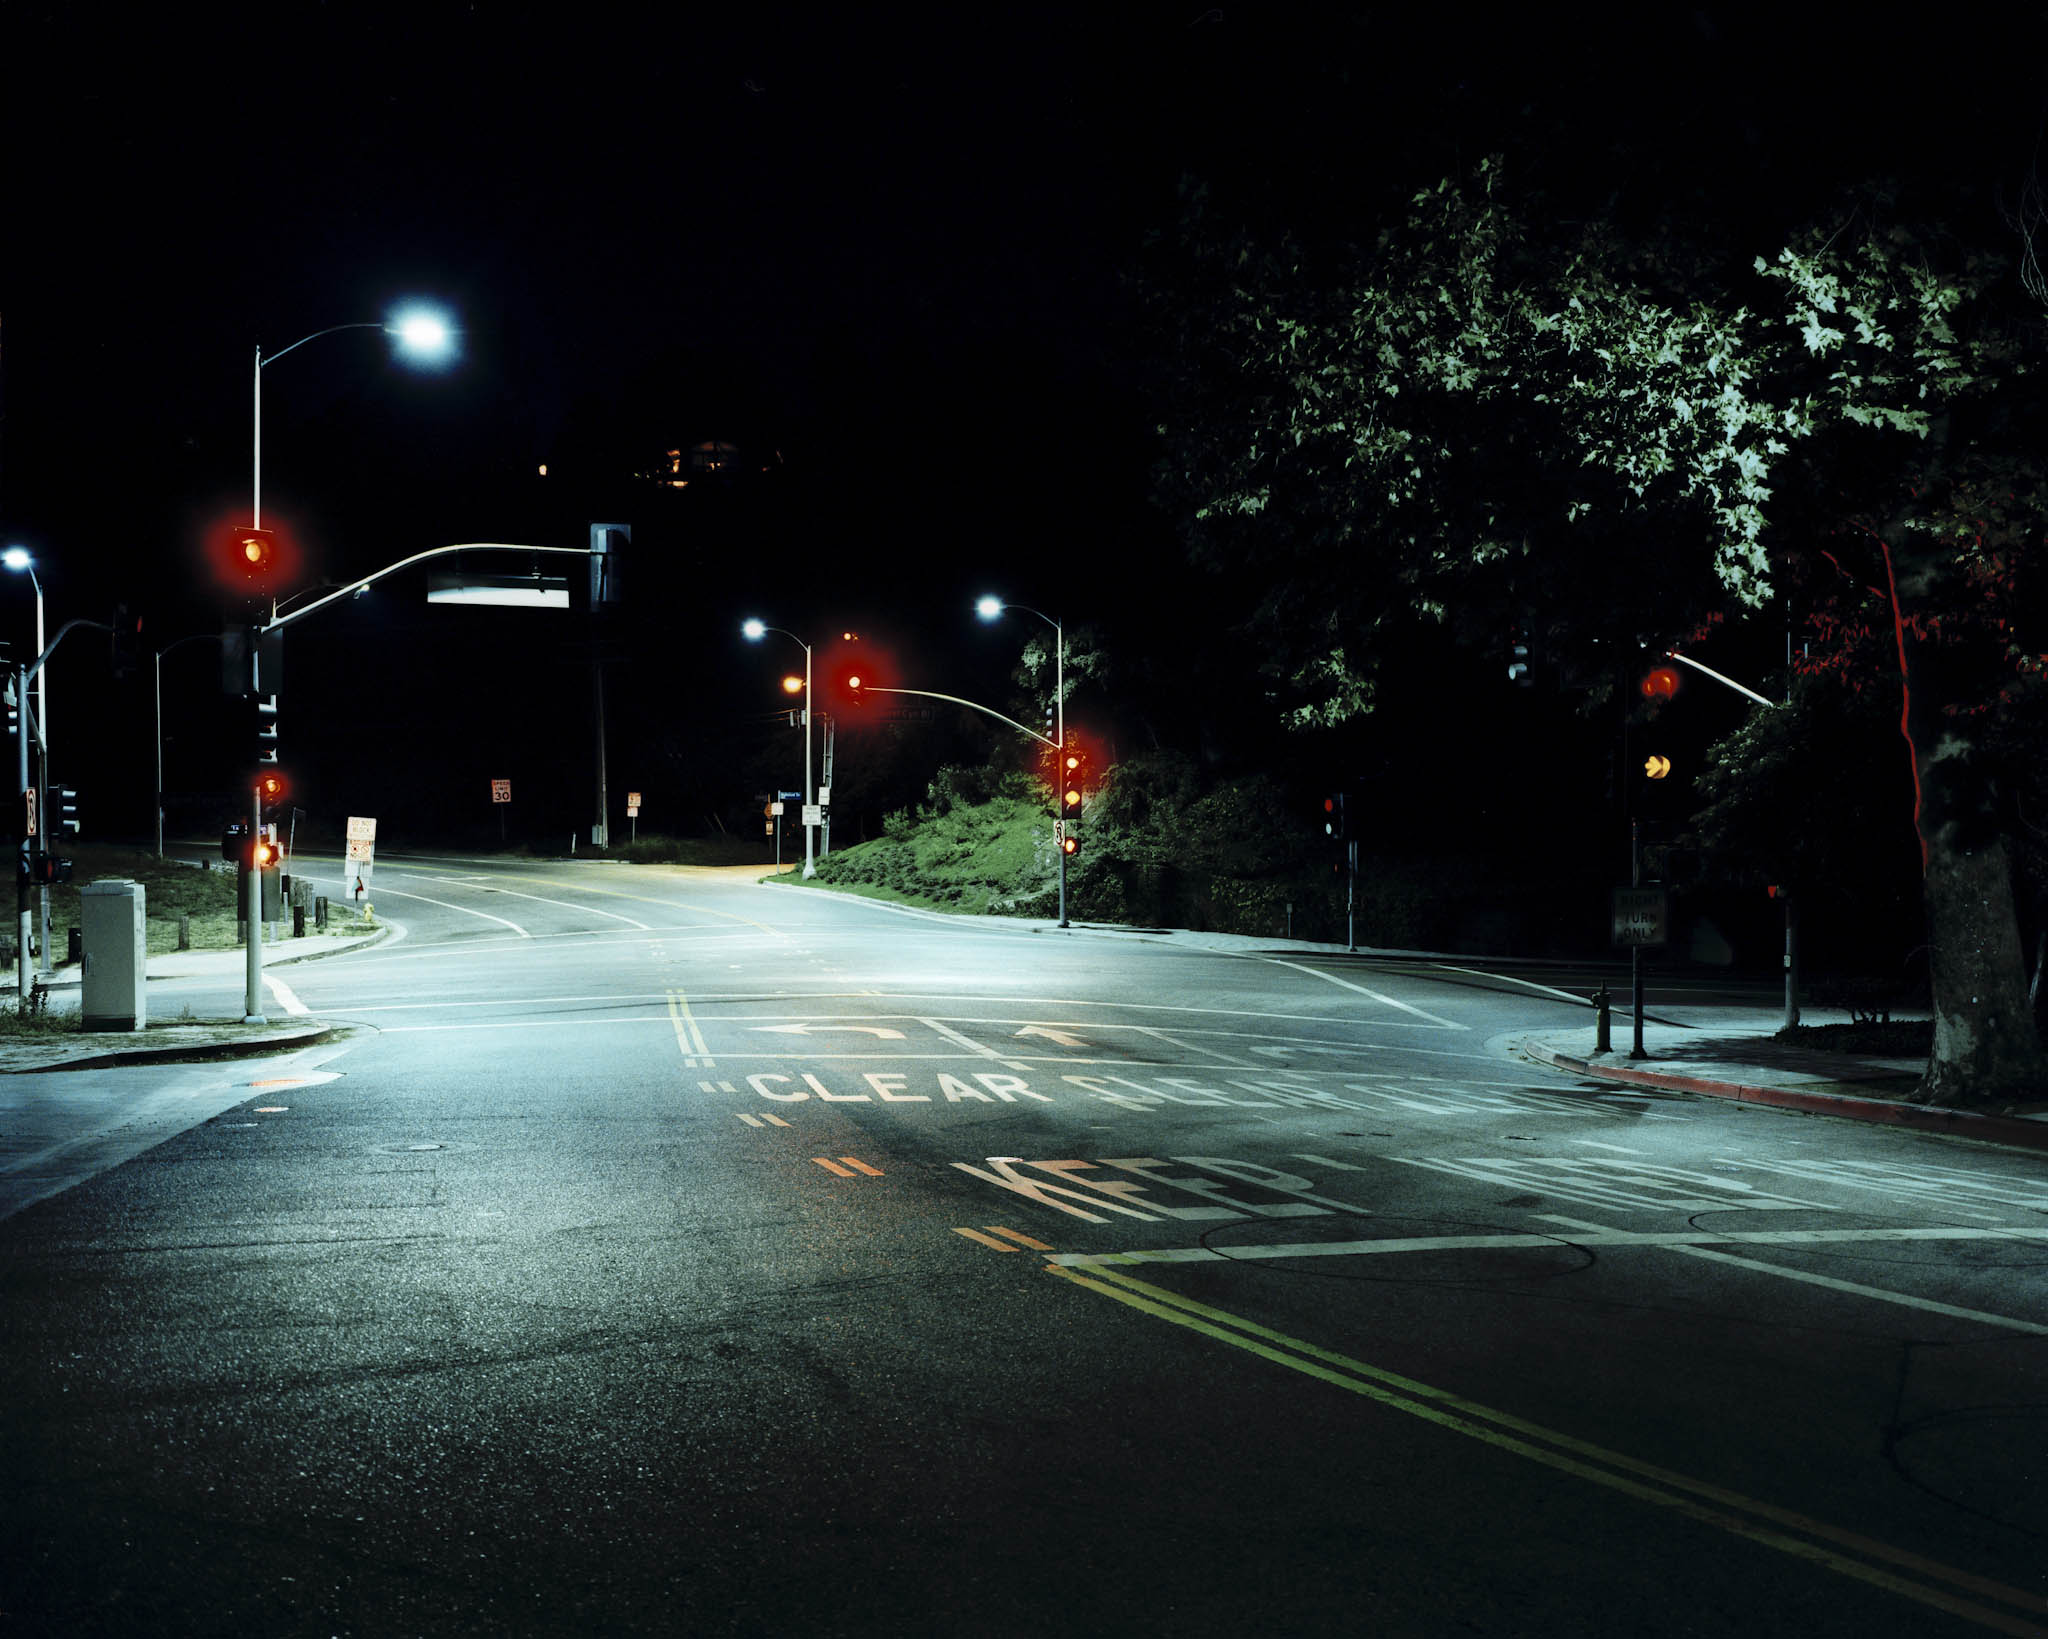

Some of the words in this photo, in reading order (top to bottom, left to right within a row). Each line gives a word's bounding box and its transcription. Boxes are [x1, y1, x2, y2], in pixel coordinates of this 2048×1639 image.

[495, 792, 509, 800] 30
[1624, 912, 1657, 923] TURN
[1624, 928, 1656, 938] ONLY
[746, 1072, 1055, 1103] CLEAR
[1061, 1074, 1381, 1113] CLEAR
[948, 1156, 1374, 1224] KEEP
[1388, 1157, 1844, 1212] KEEP
